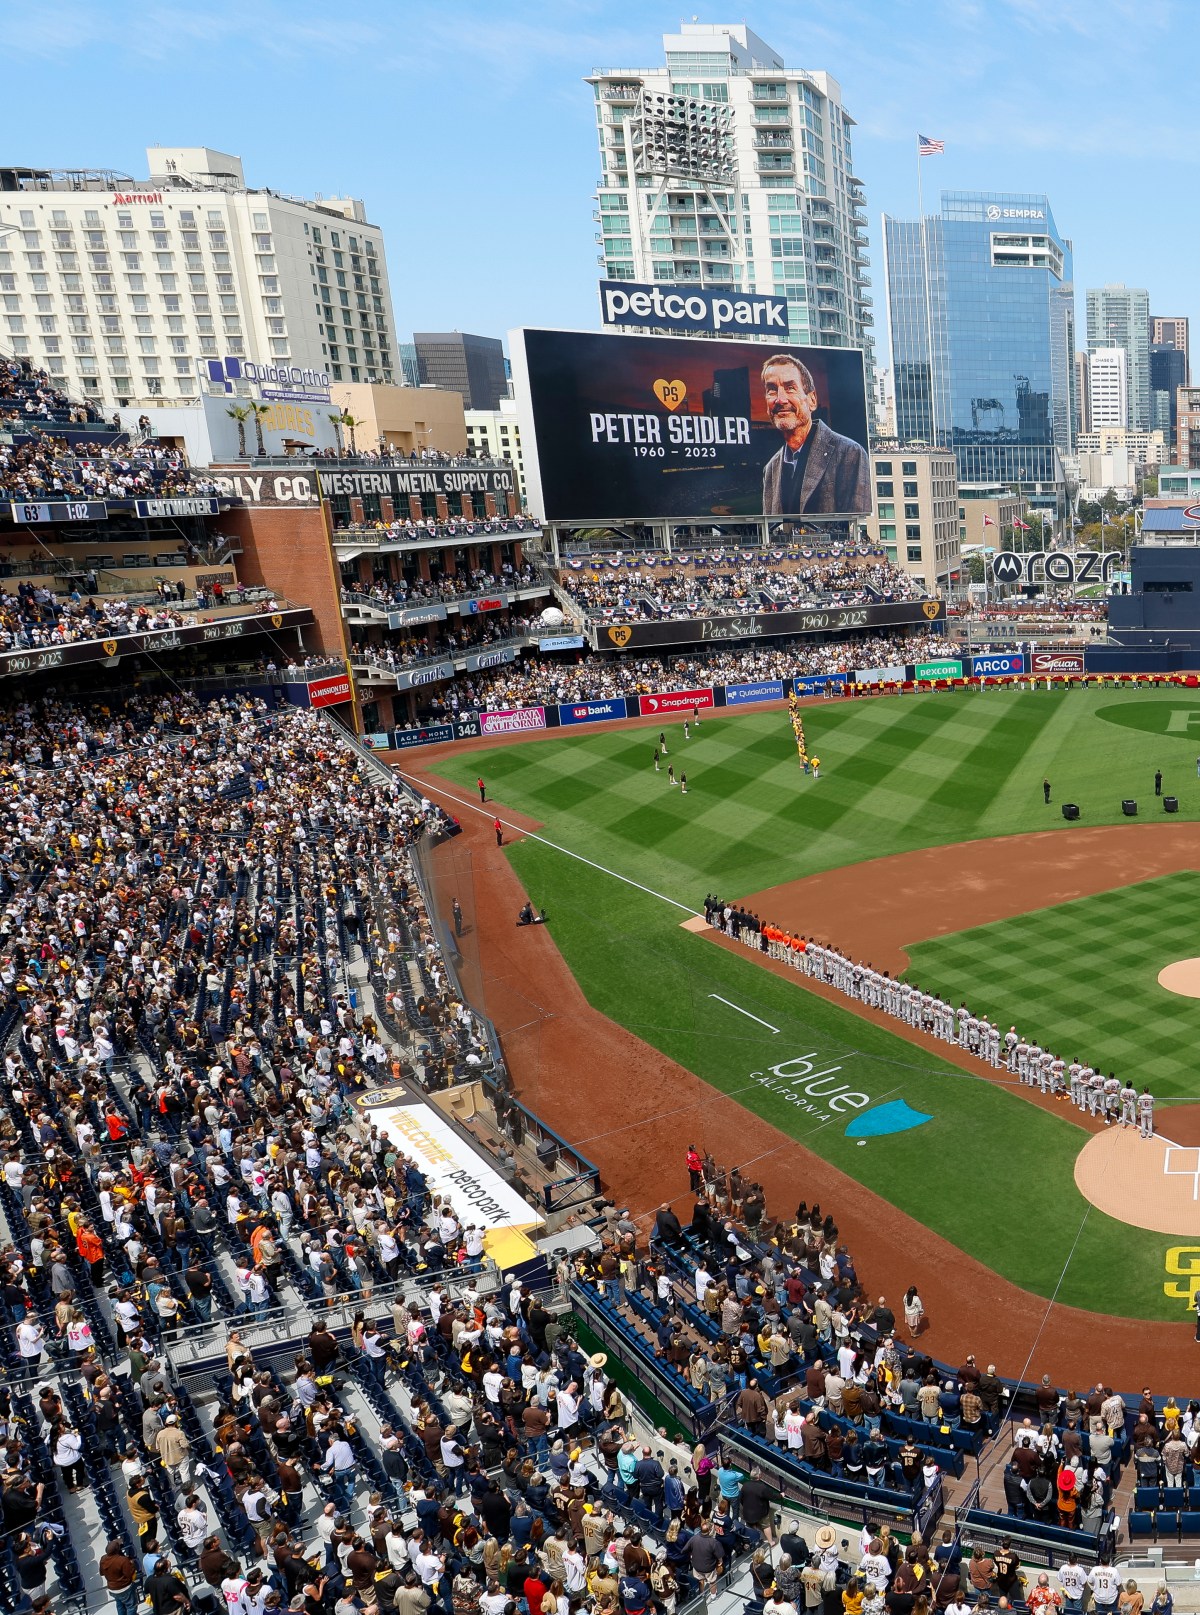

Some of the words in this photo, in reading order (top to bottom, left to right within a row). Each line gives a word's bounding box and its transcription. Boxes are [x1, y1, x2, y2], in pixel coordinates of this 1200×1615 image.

[112, 192, 163, 206] Marriott
[1003, 208, 1044, 219] SEMPRA
[605, 287, 707, 321] petco
[712, 298, 786, 329] park
[243, 362, 330, 387] QuidelOrtho
[663, 386, 679, 402] PS
[590, 413, 662, 443] PETER
[668, 415, 751, 445] SEIDLER
[633, 446, 665, 457] 1960
[685, 446, 717, 458] 2023
[273, 477, 319, 501] CO.
[319, 473, 392, 495] WESTERN
[397, 473, 441, 493] METAL
[444, 472, 489, 491] SUPPLY
[493, 472, 514, 490] CO.
[67, 503, 89, 519] 1:02
[147, 500, 212, 516] CUTWATER
[1027, 551, 1122, 583] razr
[801, 614, 829, 629] 1960
[838, 610, 867, 627] 2023
[203, 627, 220, 639] 1960
[701, 620, 728, 639] Peter
[728, 617, 764, 637] Seidler
[614, 630, 626, 641] PS
[7, 658, 31, 671] 1960
[38, 651, 62, 666] 2023
[974, 659, 1010, 673] ARCO
[1035, 654, 1080, 671] Sycuan
[409, 665, 446, 686] Canel's
[317, 685, 339, 697] MISSION
[339, 683, 349, 692] FED
[360, 687, 374, 701] 336
[739, 687, 781, 699] QuidelOrtho
[661, 693, 709, 708] Snapdragon
[518, 709, 541, 721] BAJA
[574, 708, 587, 717] us
[588, 704, 613, 715] bank
[458, 724, 477, 737] 342
[483, 718, 544, 733] CALIFORNIA
[768, 1053, 870, 1112] blue
[750, 1071, 831, 1122] CALIFORNIA
[388, 1110, 454, 1165] WELCOME
[441, 1169, 486, 1199] petco
[468, 1196, 511, 1223] park
[68, 1331, 80, 1341] 13
[730, 1355, 740, 1363] 22
[787, 1424, 800, 1433] 44
[904, 1457, 914, 1467] 13
[867, 1567, 880, 1578] 23
[999, 1564, 1008, 1574] 13
[805, 1580, 816, 1592] 44
[1065, 1577, 1077, 1587] 23
[1098, 1578, 1109, 1589] 13
[224, 1591, 239, 1603] 23
